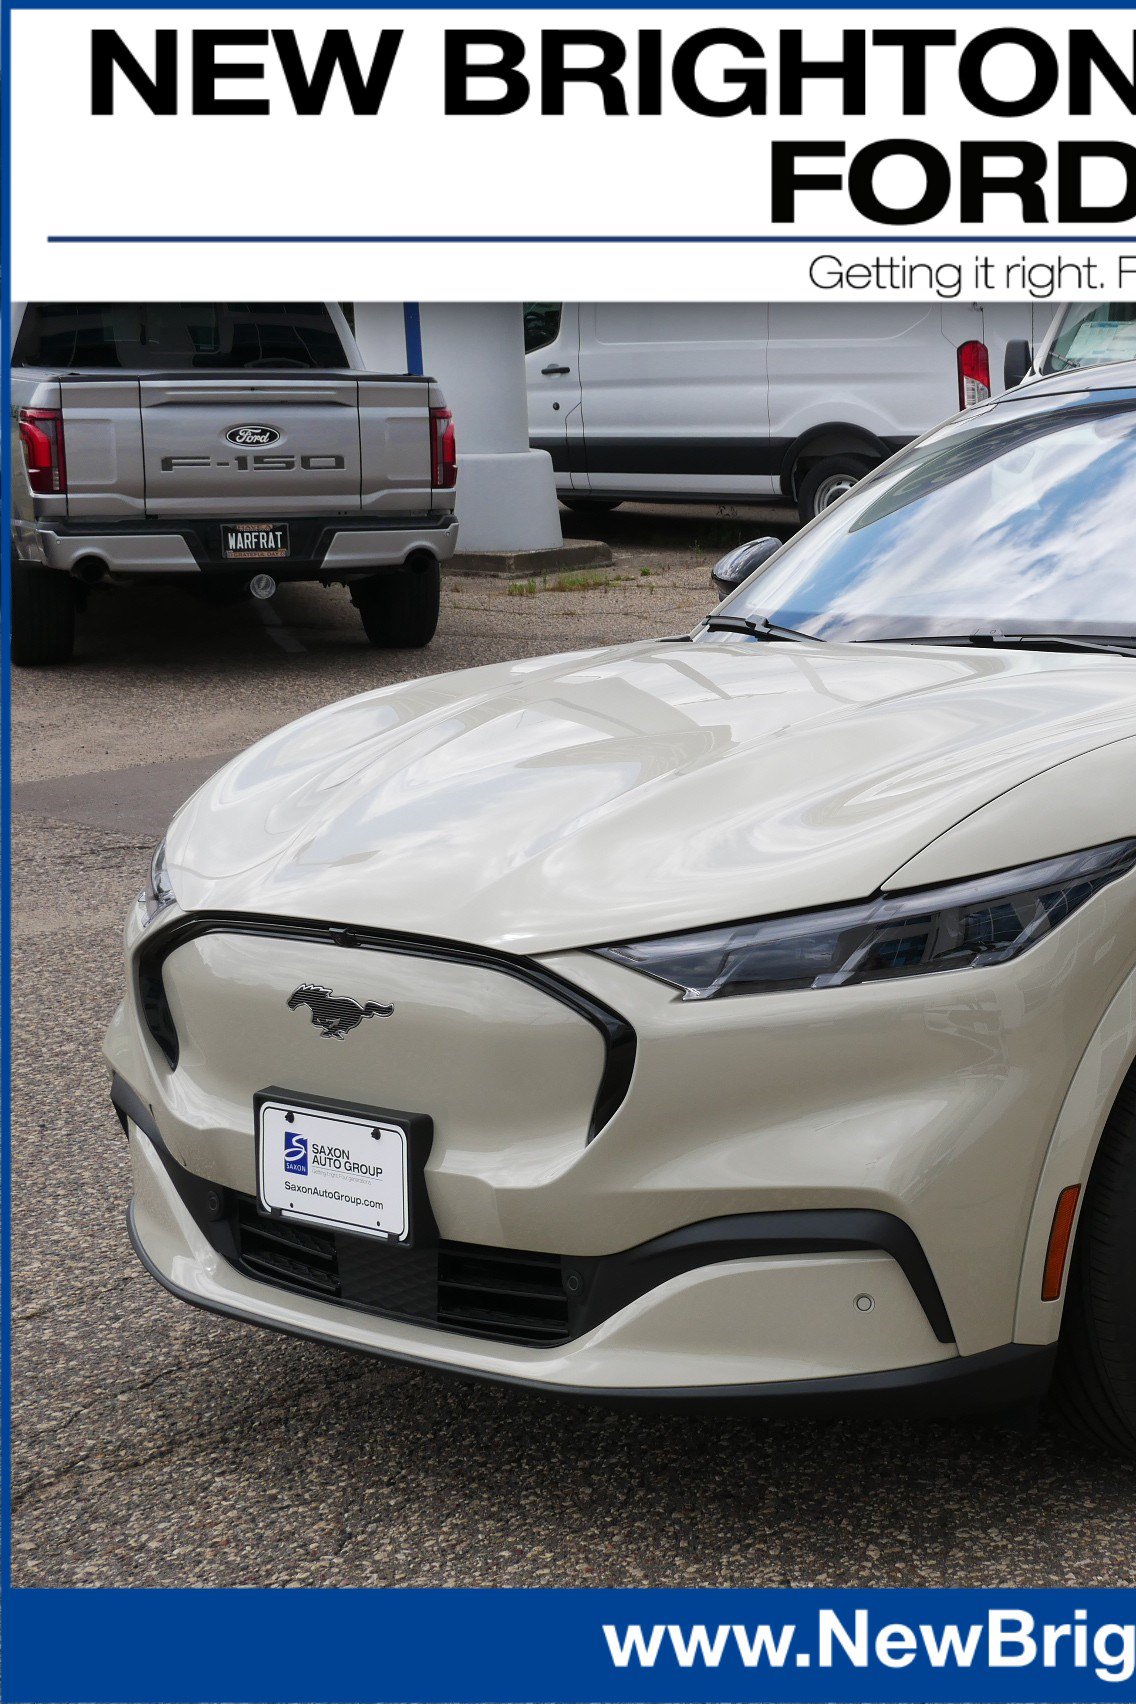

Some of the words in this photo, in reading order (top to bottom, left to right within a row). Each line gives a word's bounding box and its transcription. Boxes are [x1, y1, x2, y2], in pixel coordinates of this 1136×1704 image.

[236, 428, 270, 443] Ford
[161, 455, 346, 472] F-150
[228, 531, 283, 549] WARFRAT
[312, 1143, 350, 1160] SAXON
[286, 1162, 307, 1172] SAXON
[312, 1155, 341, 1169] AUTO
[344, 1160, 383, 1178] GROUP
[284, 1181, 384, 1210] SaxonAutoGroup.com
